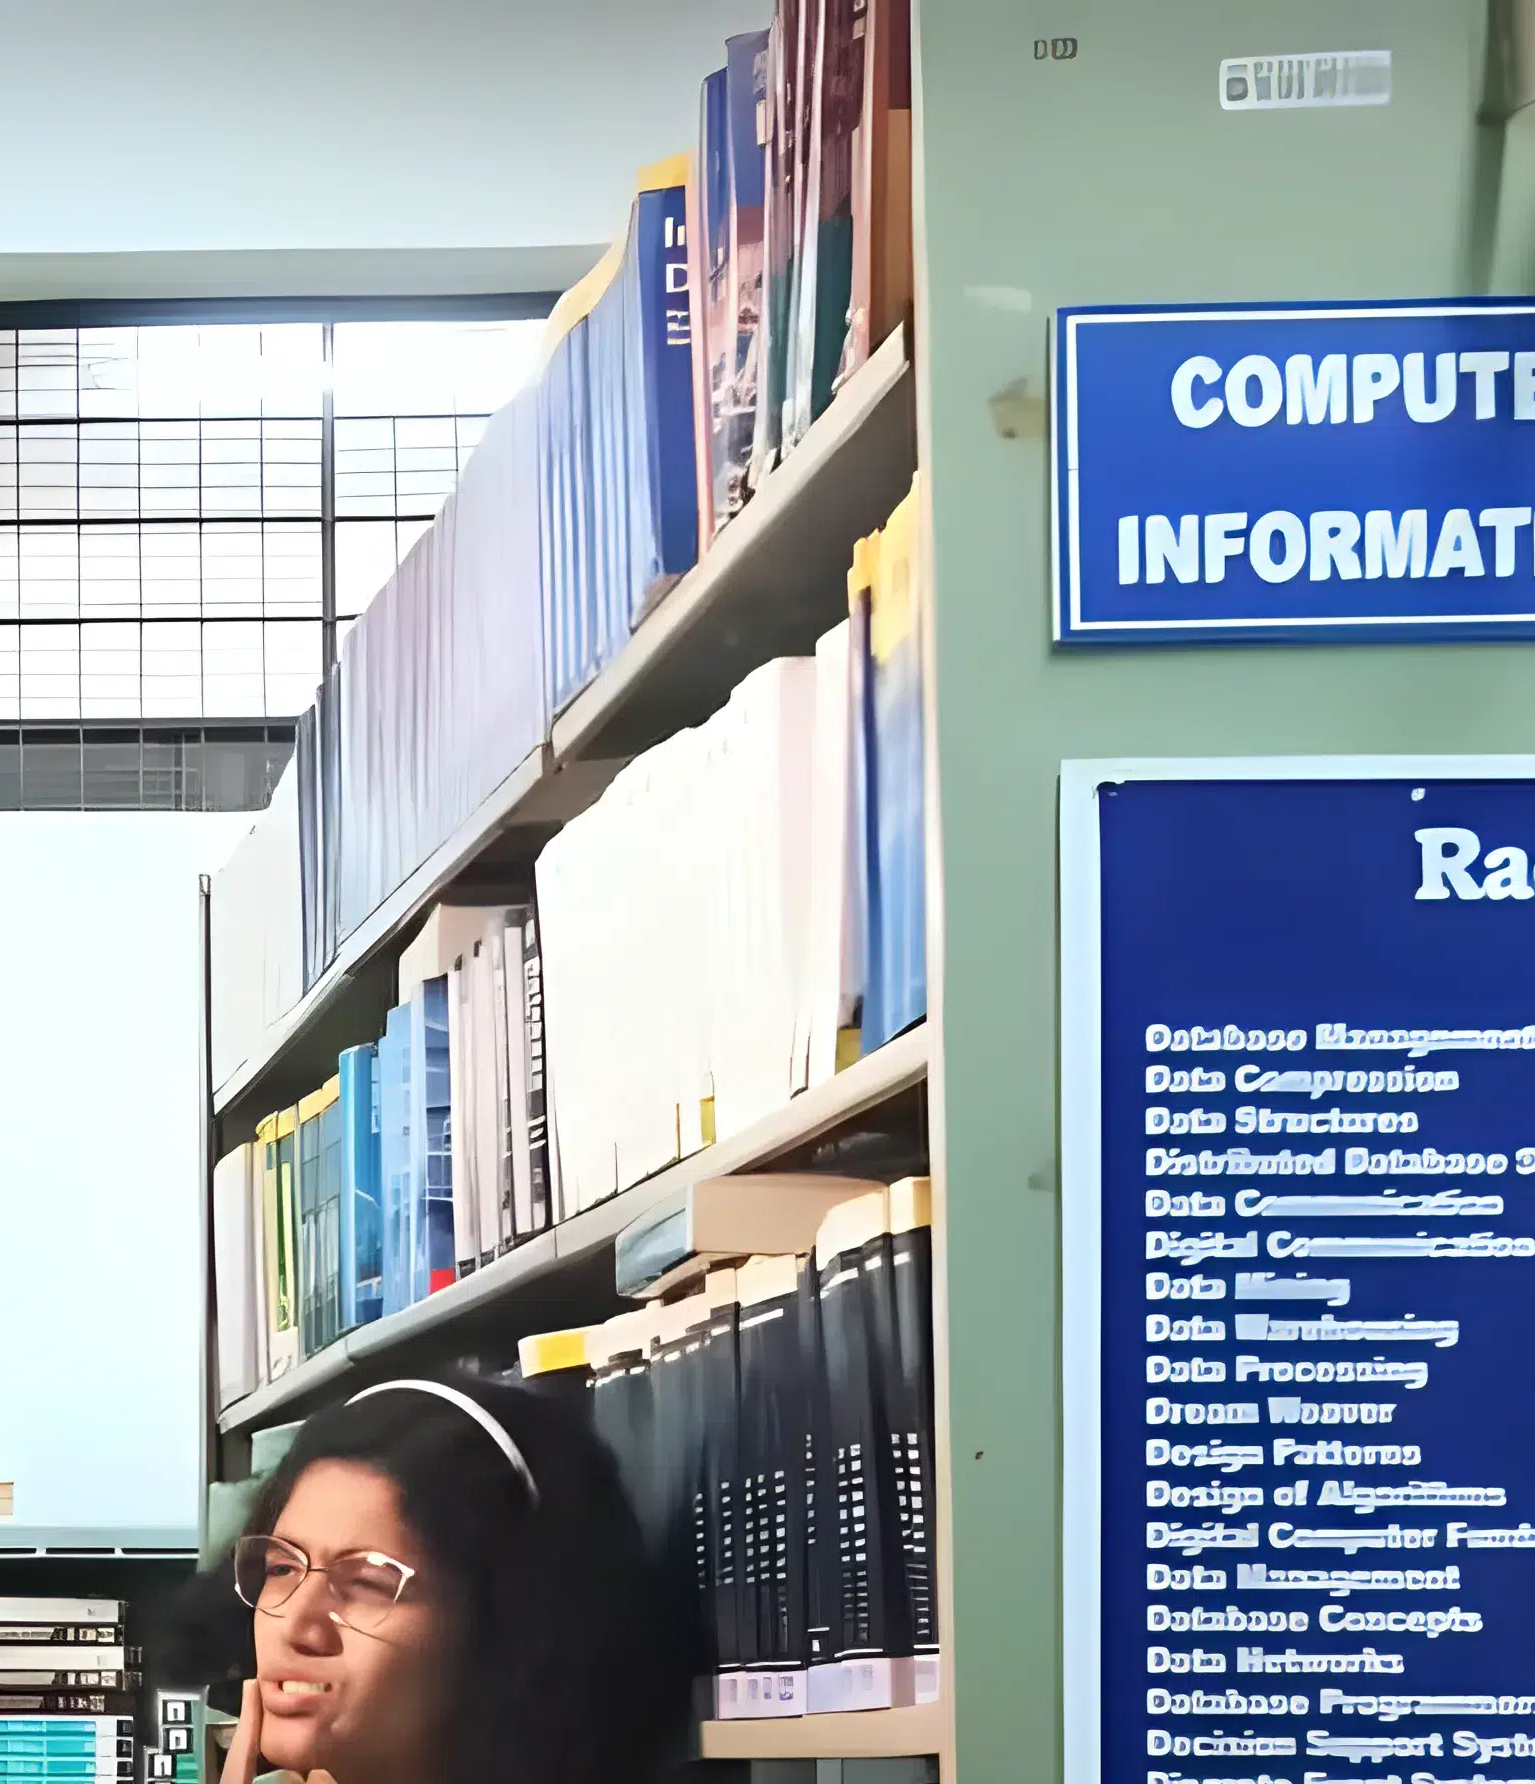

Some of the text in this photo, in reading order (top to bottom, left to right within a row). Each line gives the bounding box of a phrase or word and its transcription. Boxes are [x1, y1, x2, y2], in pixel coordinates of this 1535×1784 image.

[1144, 1022, 1308, 1052] Database
[1144, 1062, 1460, 1097] Data Compression
[1144, 1105, 1228, 1135] Data
[1234, 1104, 1420, 1134] Structures
[1145, 1146, 1337, 1176] Distributed
[1344, 1145, 1509, 1176] Database
[1144, 1187, 1227, 1217] Data
[1145, 1229, 1259, 1266] Digital
[1145, 1270, 1227, 1300] Data
[1145, 1312, 1227, 1342] Data
[1145, 1353, 1429, 1389] Data Processing
[1145, 1438, 1265, 1474] Design
[1272, 1437, 1422, 1467] Patterns
[1145, 1479, 1265, 1515] Design
[1145, 1521, 1260, 1557] Digital
[1267, 1521, 1439, 1556] Computer
[1145, 1562, 1228, 1591] Data
[1236, 1562, 1462, 1598] Management
[1146, 1604, 1310, 1633] Database
[1318, 1604, 1484, 1638] Concepts
[1146, 1645, 1227, 1674] Data
[1146, 1687, 1310, 1716] Database
[1146, 1728, 1298, 1757] Decision
[1305, 1729, 1445, 1764] Support
